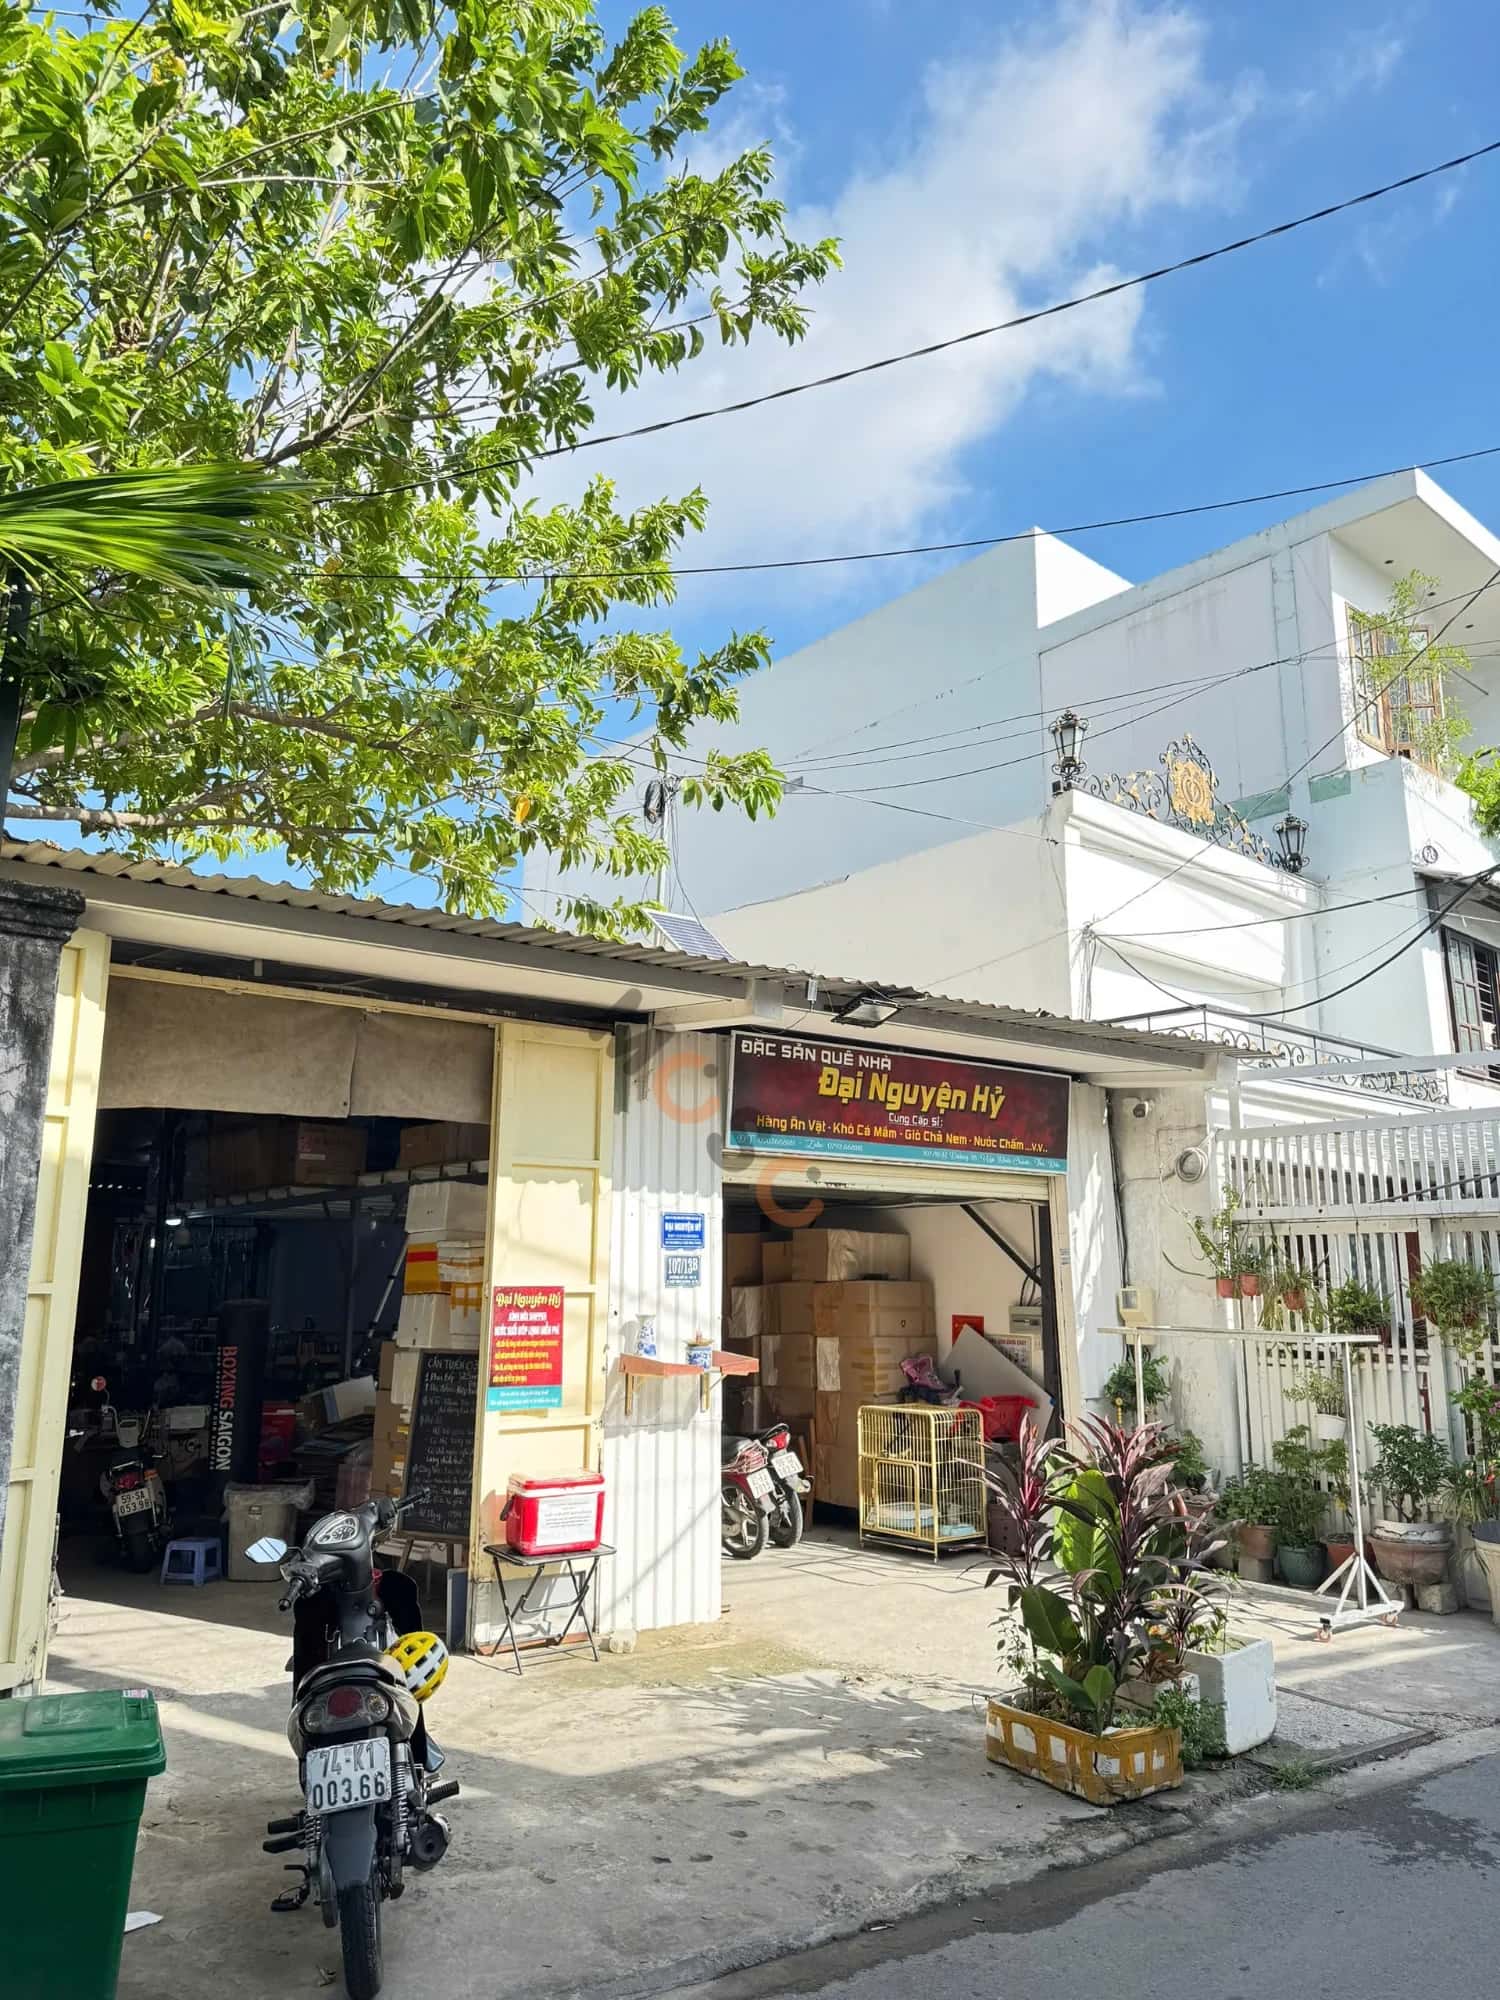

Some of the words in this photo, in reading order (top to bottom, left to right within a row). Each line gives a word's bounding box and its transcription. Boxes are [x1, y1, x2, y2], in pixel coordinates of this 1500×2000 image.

[741, 1038, 776, 1057] ĐẶC
[781, 1043, 816, 1062] SẢN
[820, 1049, 854, 1066] QUÊ
[858, 1054, 892, 1071] NHÀ
[818, 1066, 864, 1104] Đại
[868, 1073, 967, 1115] Nguyện
[971, 1084, 1006, 1119] Hỷ
[756, 1114, 787, 1133] Hàng
[790, 1115, 806, 1131] Ăn
[808, 1120, 826, 1135] Vật
[857, 1124, 871, 1137] Cá
[923, 1130, 943, 1143] Chả
[946, 1133, 967, 1145] Nem
[888, 1112, 910, 1126] Cung
[668, 1257, 698, 1274] 107/13B
[220, 1346, 239, 1409] BOXING
[215, 1410, 234, 1470] SAIGON
[320, 1742, 375, 1778] 74-K1
[313, 1771, 385, 1810] 003.66
